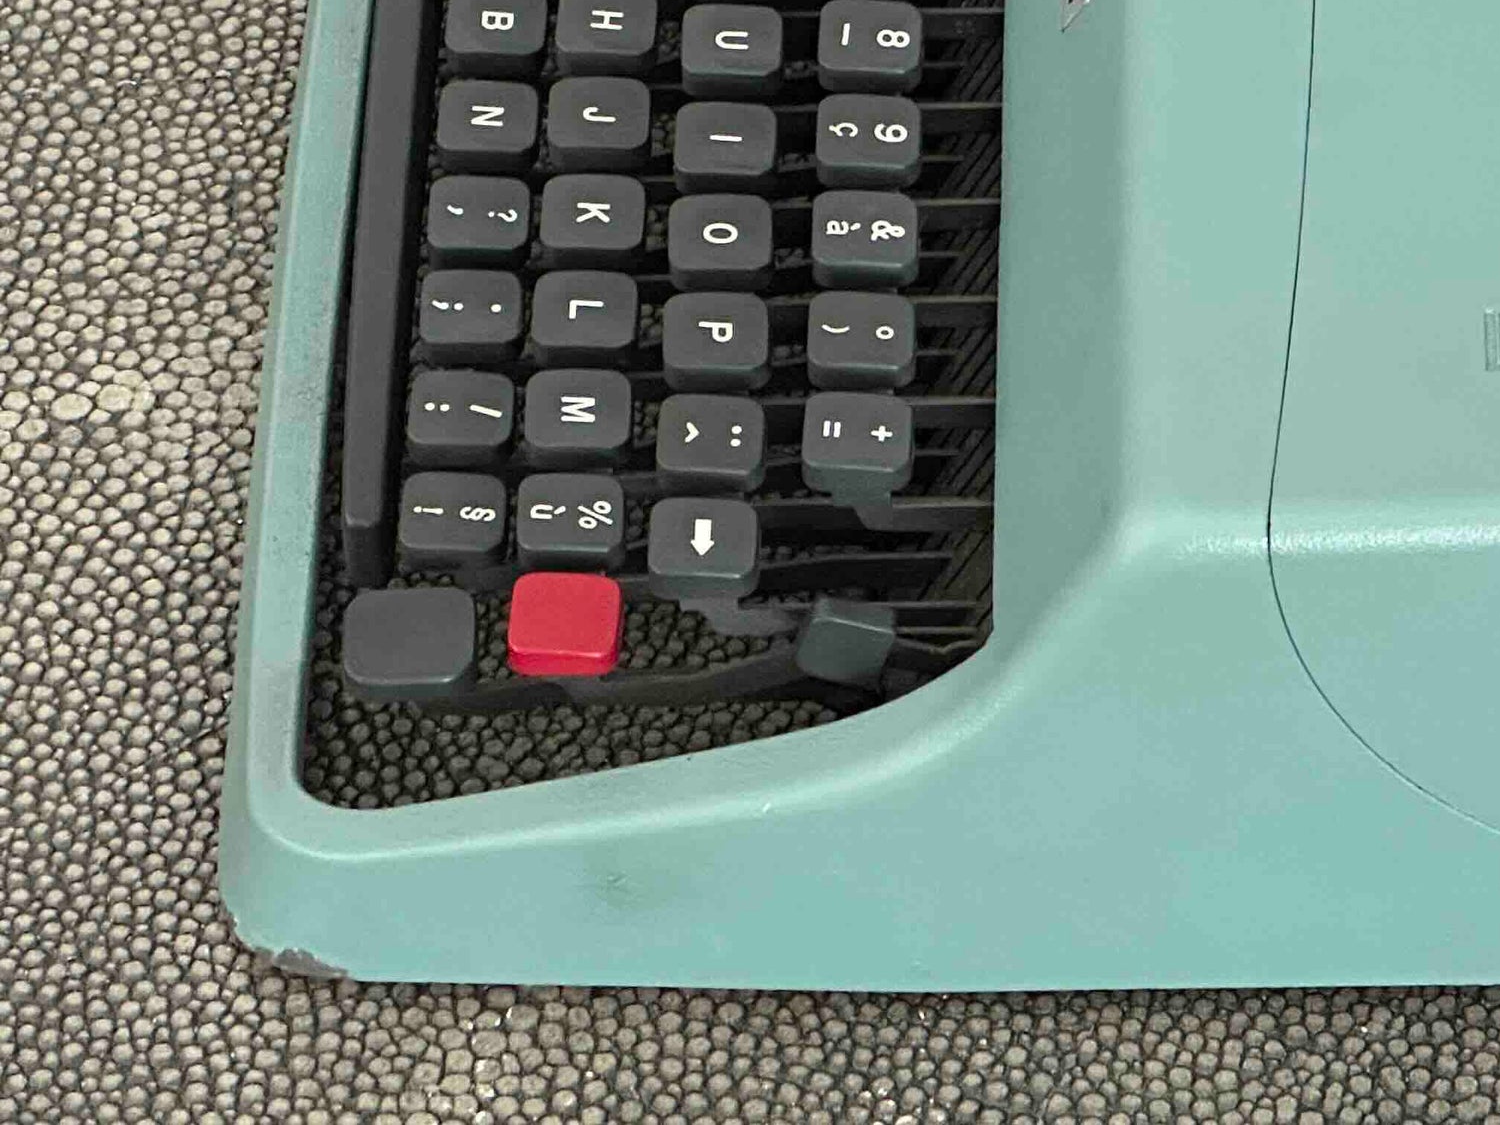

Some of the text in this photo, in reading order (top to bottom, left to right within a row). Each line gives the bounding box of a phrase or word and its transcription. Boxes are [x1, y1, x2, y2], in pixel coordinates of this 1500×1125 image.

[481, 10, 515, 31] B
[589, 9, 625, 31] H
[714, 30, 750, 50] U
[876, 29, 911, 49] 8
[470, 105, 505, 127] N
[582, 106, 617, 123] J
[709, 134, 743, 143] I
[828, 122, 859, 138] ç
[873, 122, 908, 143] 9
[487, 208, 518, 225] ?
[575, 202, 611, 224] K
[702, 222, 739, 244] O
[825, 218, 862, 237] à
[870, 219, 906, 242] &
[430, 299, 464, 311] ;
[568, 299, 605, 320] L
[698, 320, 734, 343] P
[821, 324, 851, 334] )
[424, 402, 450, 412] :
[469, 404, 503, 418] /
[560, 395, 596, 423] M
[822, 419, 842, 440] =
[870, 425, 894, 442] +
[412, 505, 445, 516] !
[459, 506, 497, 522] §
[529, 503, 568, 522] ù
[576, 498, 615, 531] %
